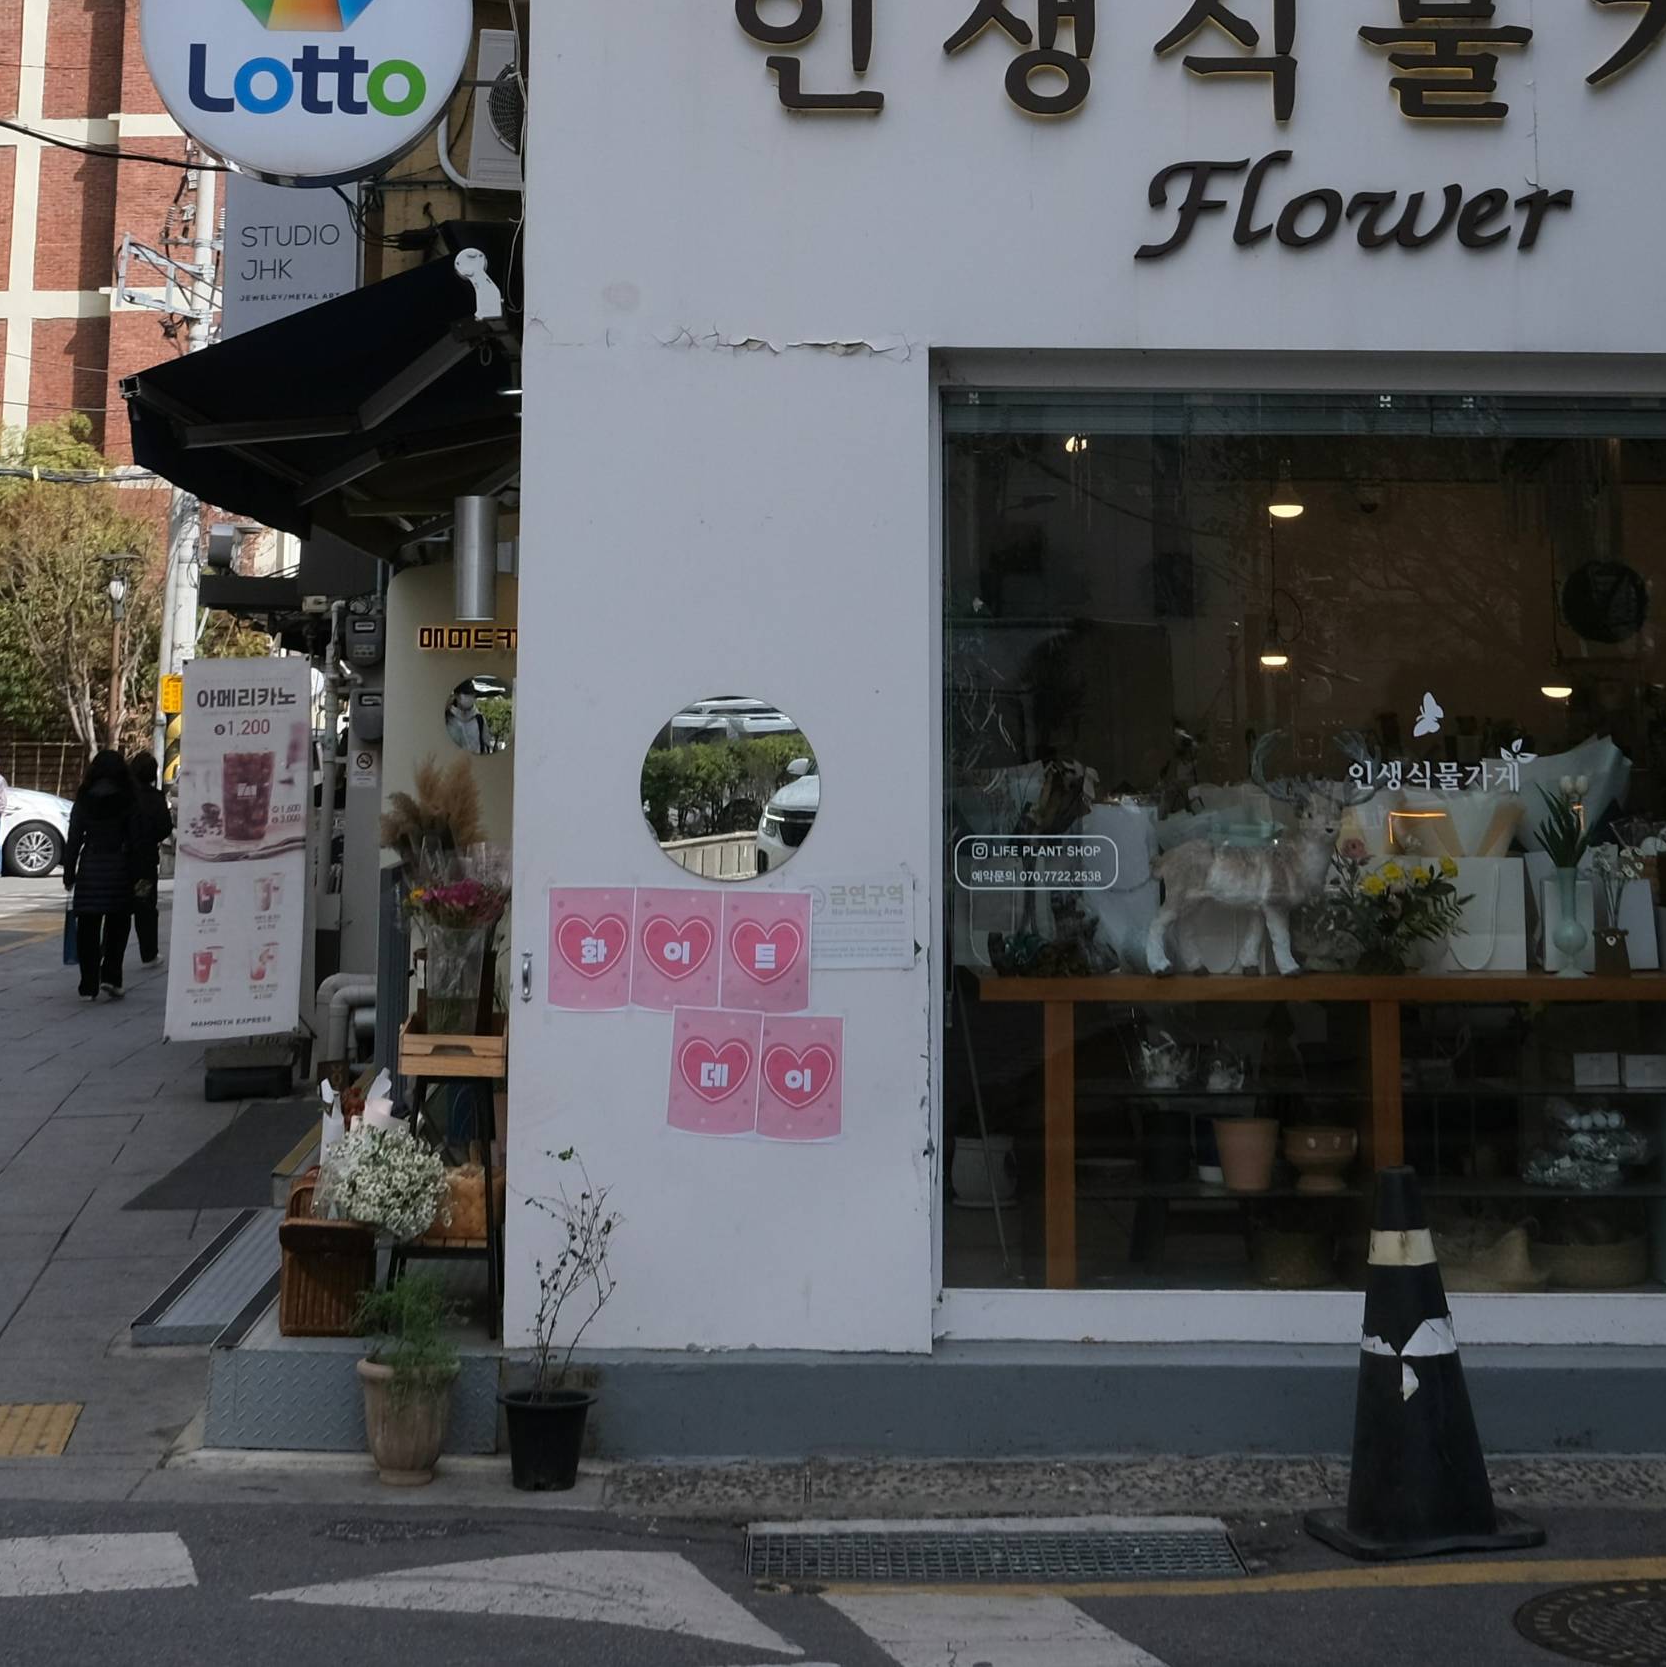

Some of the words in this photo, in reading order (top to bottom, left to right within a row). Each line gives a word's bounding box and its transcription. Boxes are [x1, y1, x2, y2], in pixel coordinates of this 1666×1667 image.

[188, 43, 426, 117] Lotto
[1133, 149, 1574, 260] Flower
[240, 223, 341, 249] STUDIO
[240, 258, 293, 282] JHK
[196, 687, 296, 709] 아메리카노
[1348, 760, 1519, 792] 인생식물가게
[992, 845, 1018, 857] LIFE
[1023, 845, 1063, 857] PLANT
[1066, 845, 1101, 857] SHOP
[830, 883, 905, 906] 금연구역
